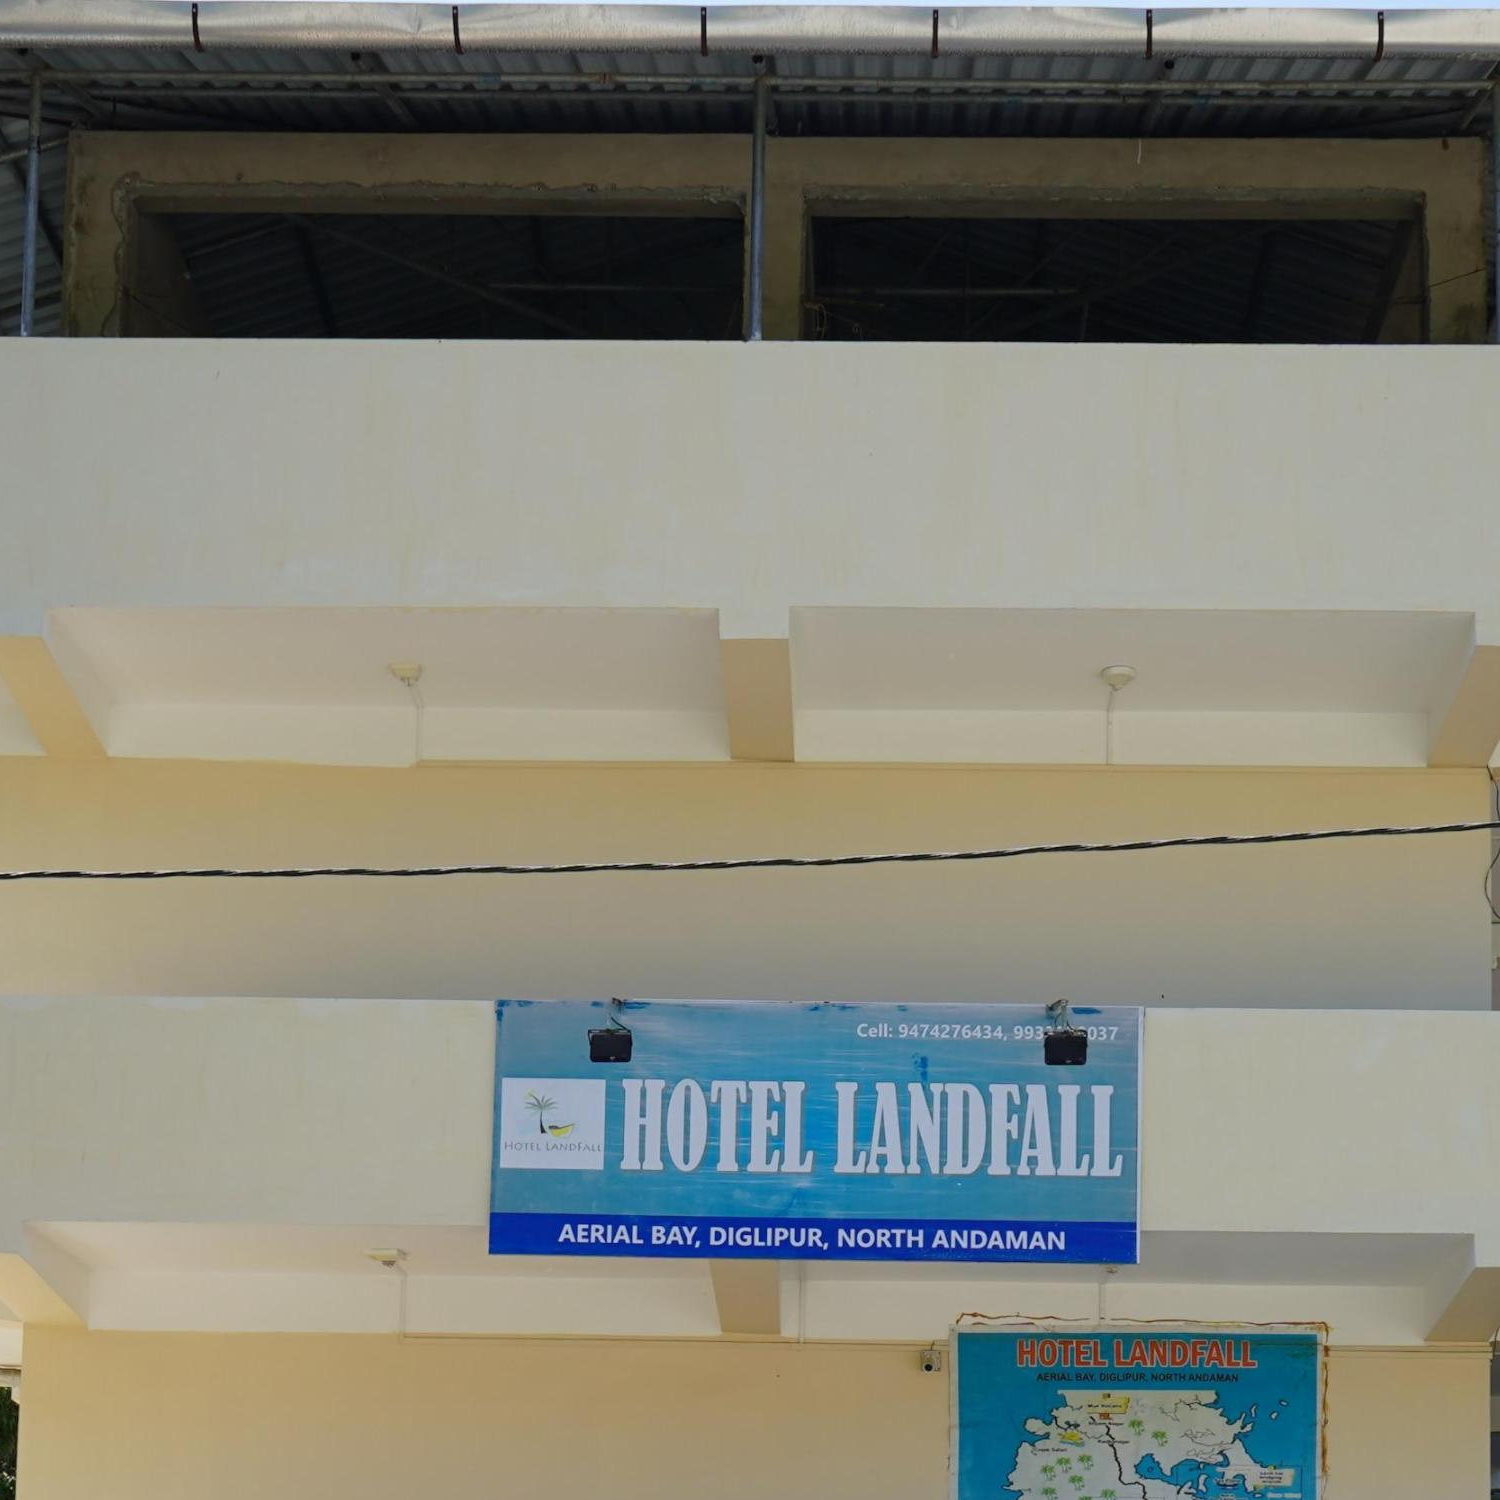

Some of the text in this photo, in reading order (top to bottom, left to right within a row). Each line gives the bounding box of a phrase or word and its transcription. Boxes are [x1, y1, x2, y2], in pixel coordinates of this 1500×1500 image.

[857, 1023, 893, 1038] Cell:
[898, 1024, 1007, 1041] 9474276434,
[620, 1078, 1124, 1178] HOTEL LANDFALL
[558, 1223, 1066, 1251] AERIAL BAY, DIGLIPUR, NORTH ANDAMAN
[1017, 1339, 1258, 1368] HOTEL LANDFALL
[1036, 1372, 1073, 1382] AERIAL
[1151, 1373, 1186, 1383] NORTH
[1188, 1374, 1238, 1383] ANDAMAN
